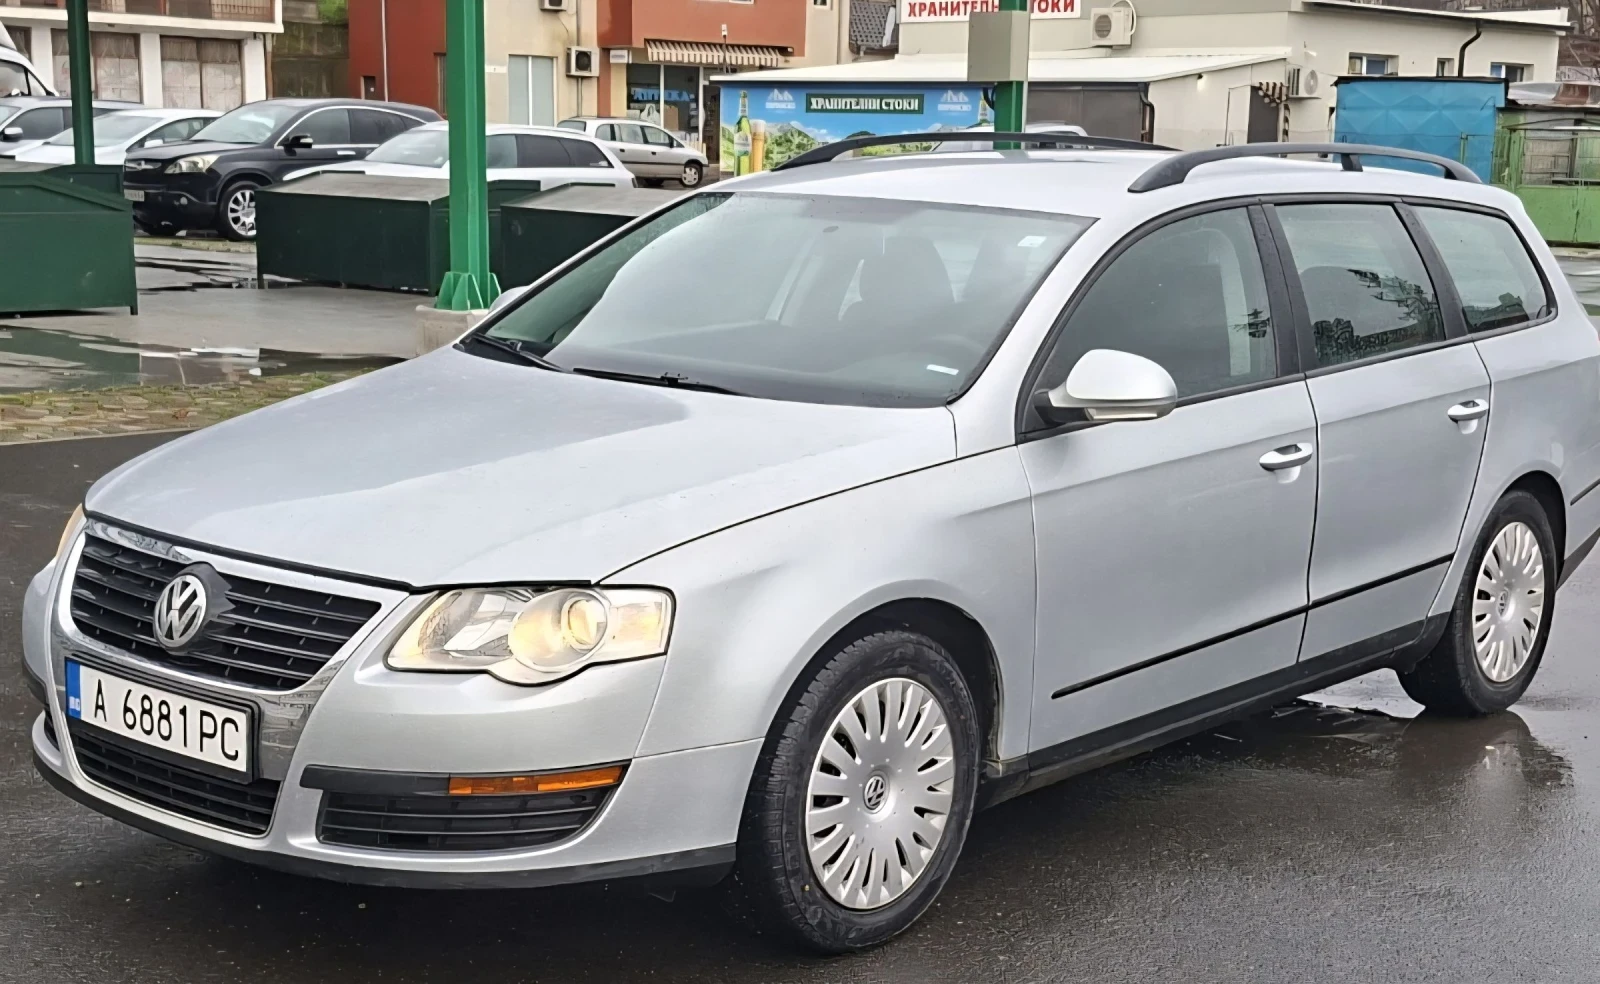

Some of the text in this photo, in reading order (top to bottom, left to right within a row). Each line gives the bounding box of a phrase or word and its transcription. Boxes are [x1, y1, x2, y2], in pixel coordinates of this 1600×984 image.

[908, 0, 1074, 17] ХРАНИТЕЛН ТОКИ
[882, 98, 919, 110] СТОКИ
[94, 678, 107, 722] A
